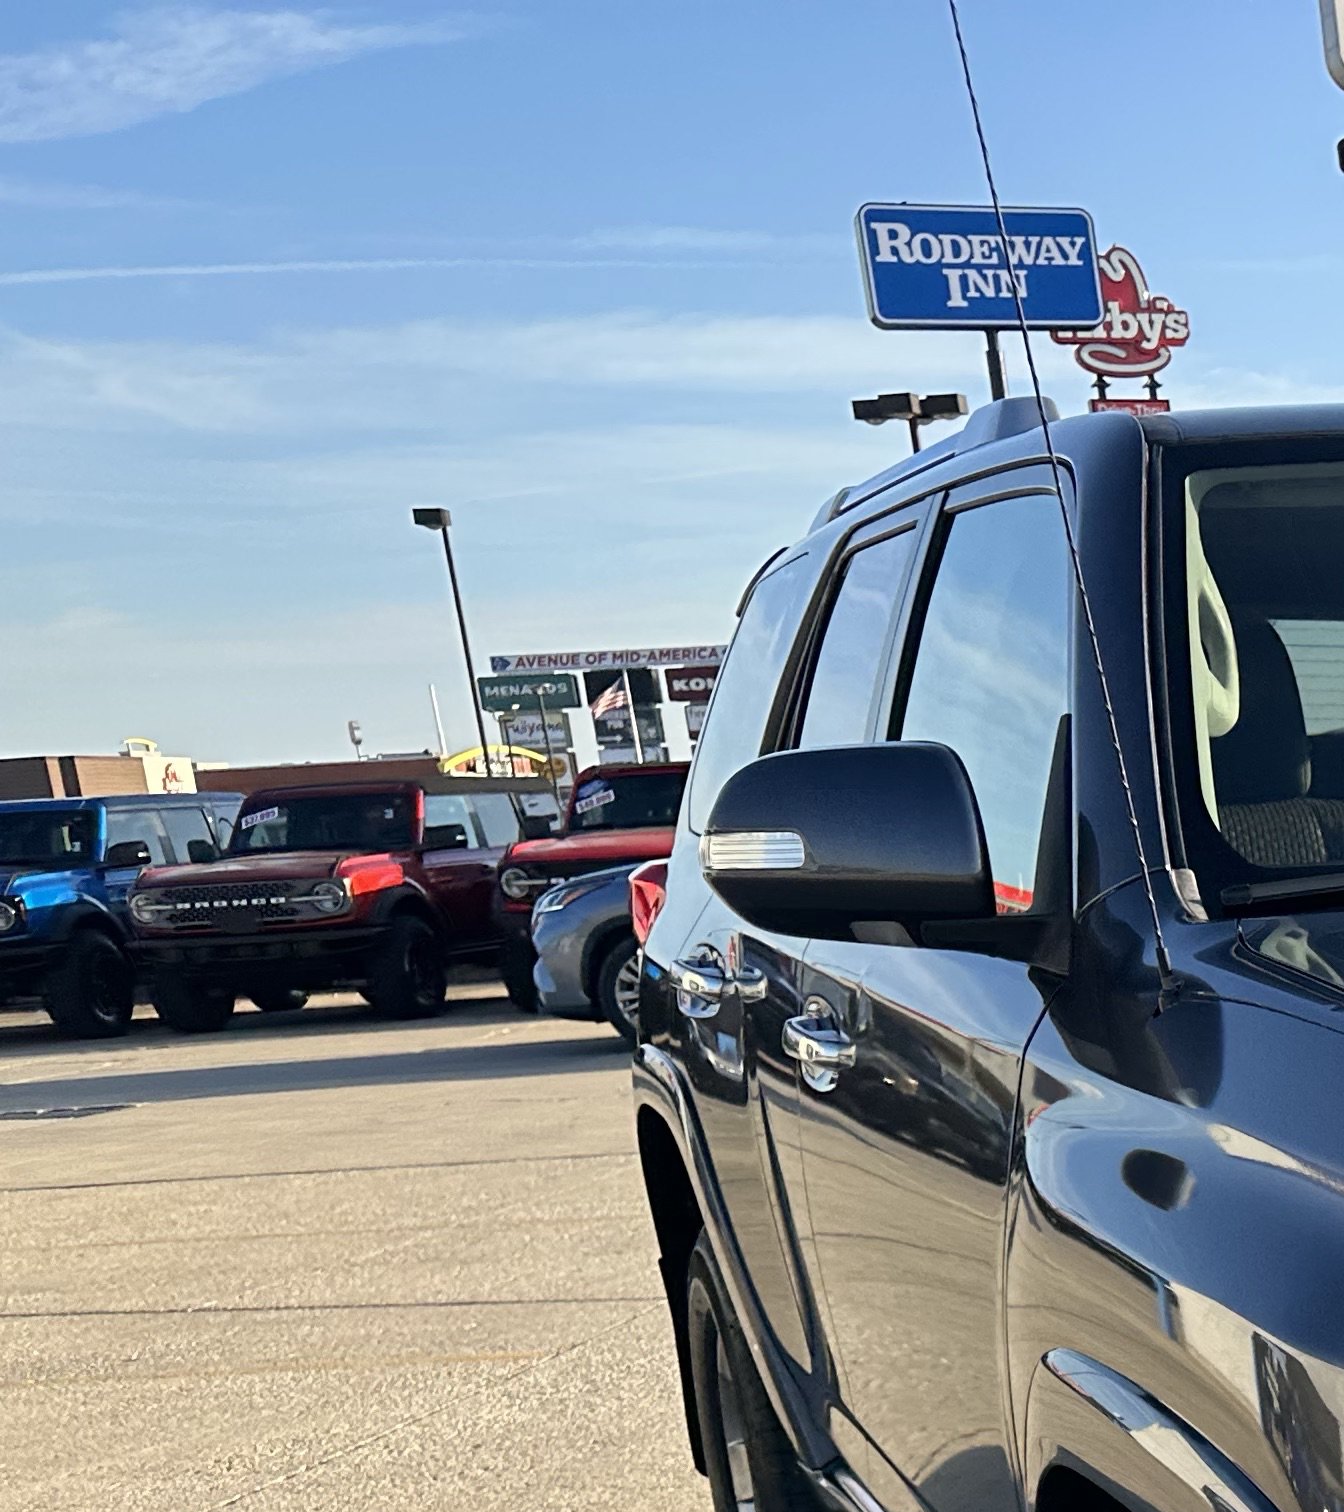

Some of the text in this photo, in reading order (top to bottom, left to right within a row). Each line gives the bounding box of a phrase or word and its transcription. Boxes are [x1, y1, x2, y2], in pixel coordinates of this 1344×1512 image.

[942, 268, 1028, 307] INN
[1058, 299, 1189, 349] rby's
[515, 648, 718, 669] AVENUE OF MID-AMERICA
[484, 682, 568, 697] MENADS
